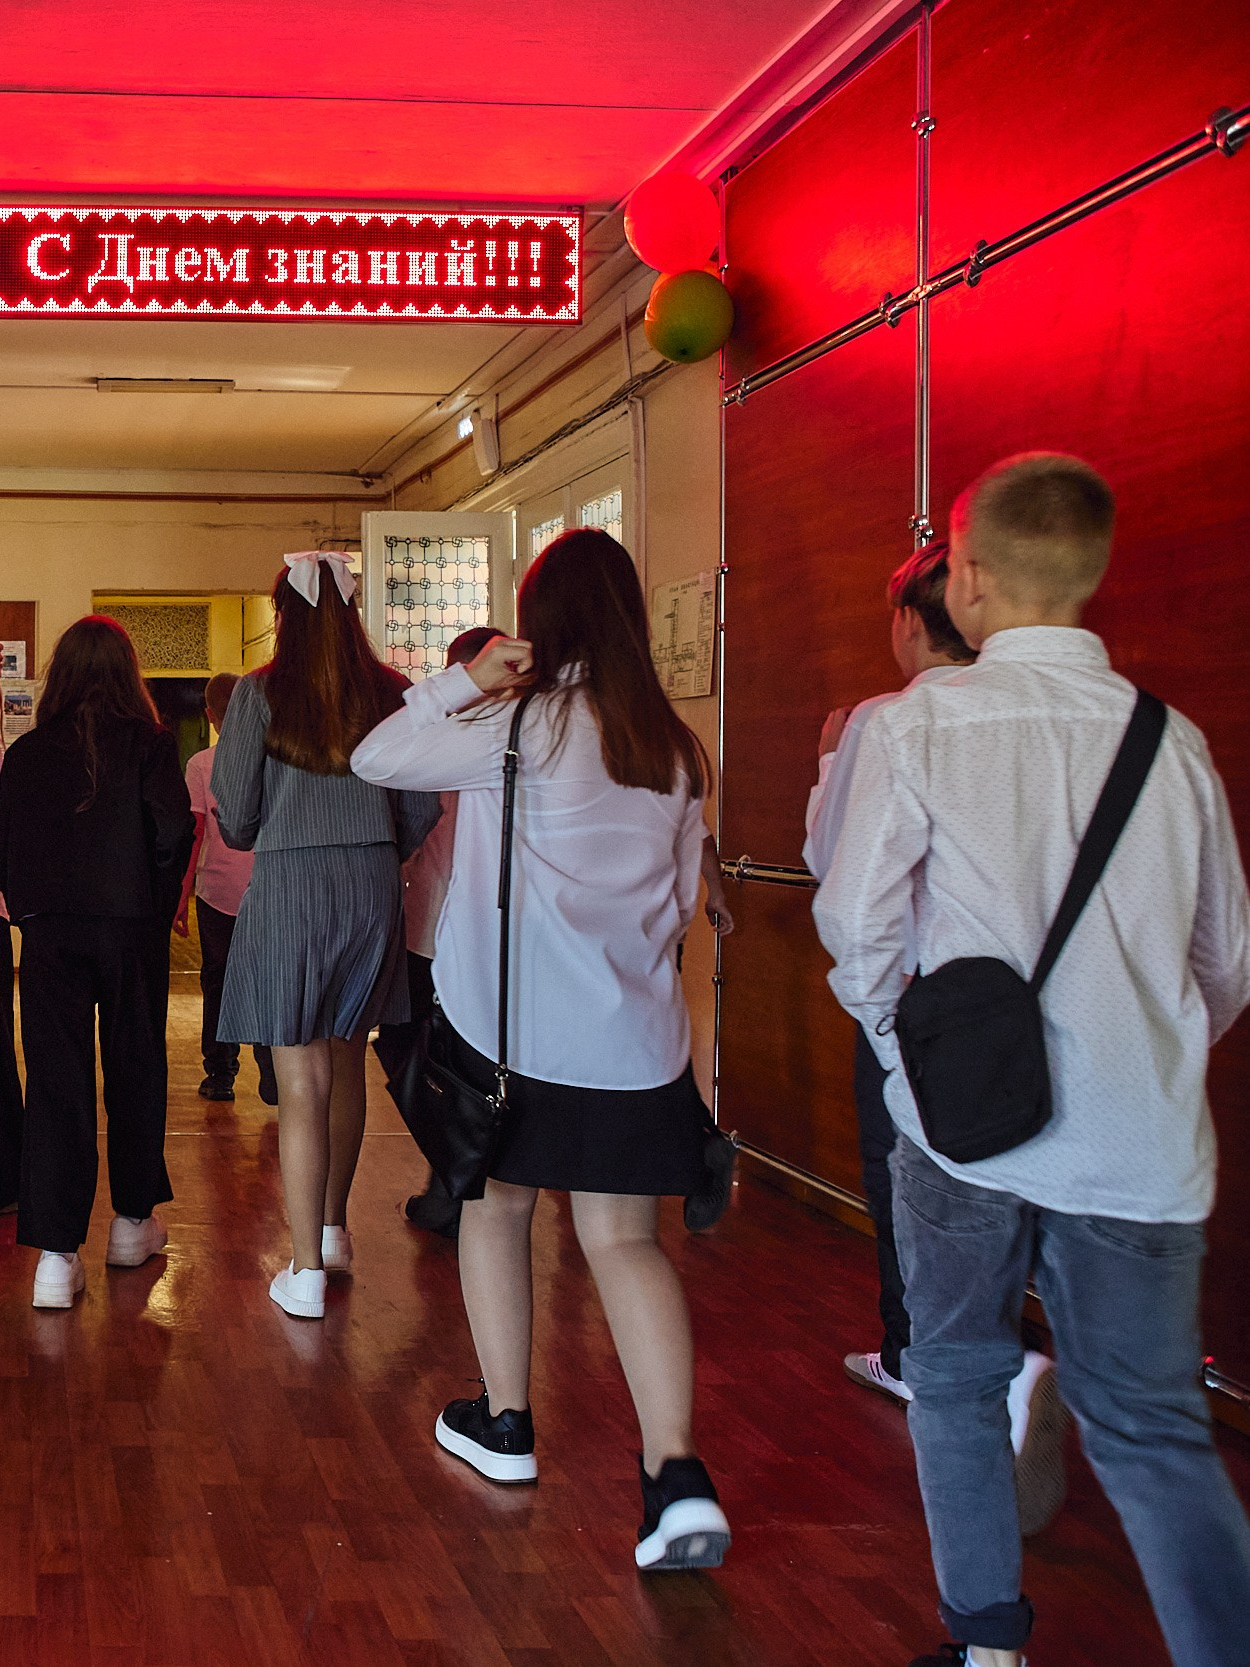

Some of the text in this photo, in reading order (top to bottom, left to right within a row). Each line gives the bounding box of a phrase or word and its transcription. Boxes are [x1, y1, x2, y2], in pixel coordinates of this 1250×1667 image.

[26, 233, 542, 294] С Днем знаний!!!
